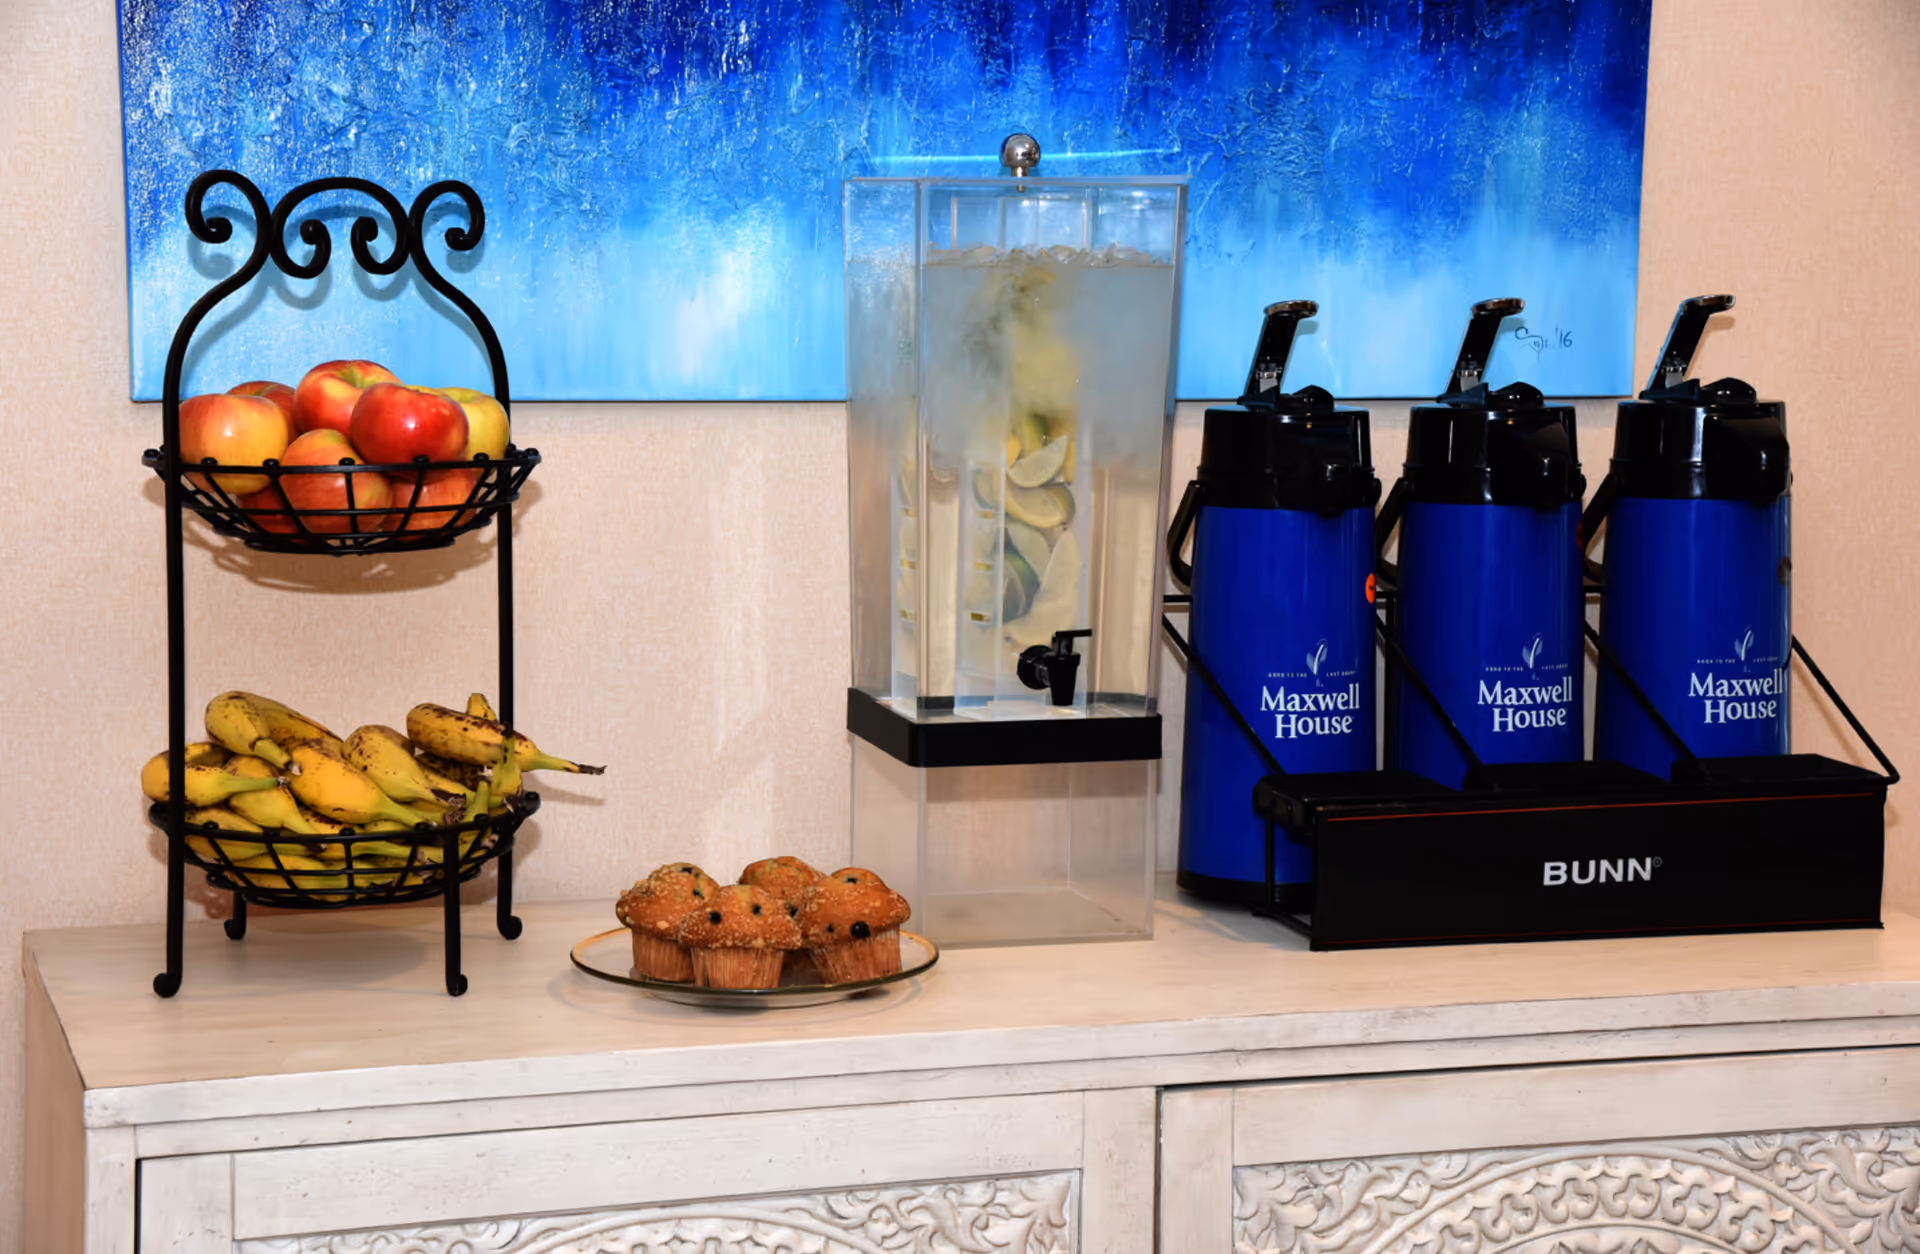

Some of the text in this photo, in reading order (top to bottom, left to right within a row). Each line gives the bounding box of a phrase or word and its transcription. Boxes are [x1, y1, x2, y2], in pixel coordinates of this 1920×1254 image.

[1477, 676, 1572, 705] Maxwell
[1688, 668, 1783, 697] Maxwell
[1260, 683, 1360, 712] Maxwell
[1704, 699, 1777, 724] House
[1275, 714, 1353, 739] House
[1492, 707, 1567, 732] House
[1543, 857, 1652, 886] BUNN
